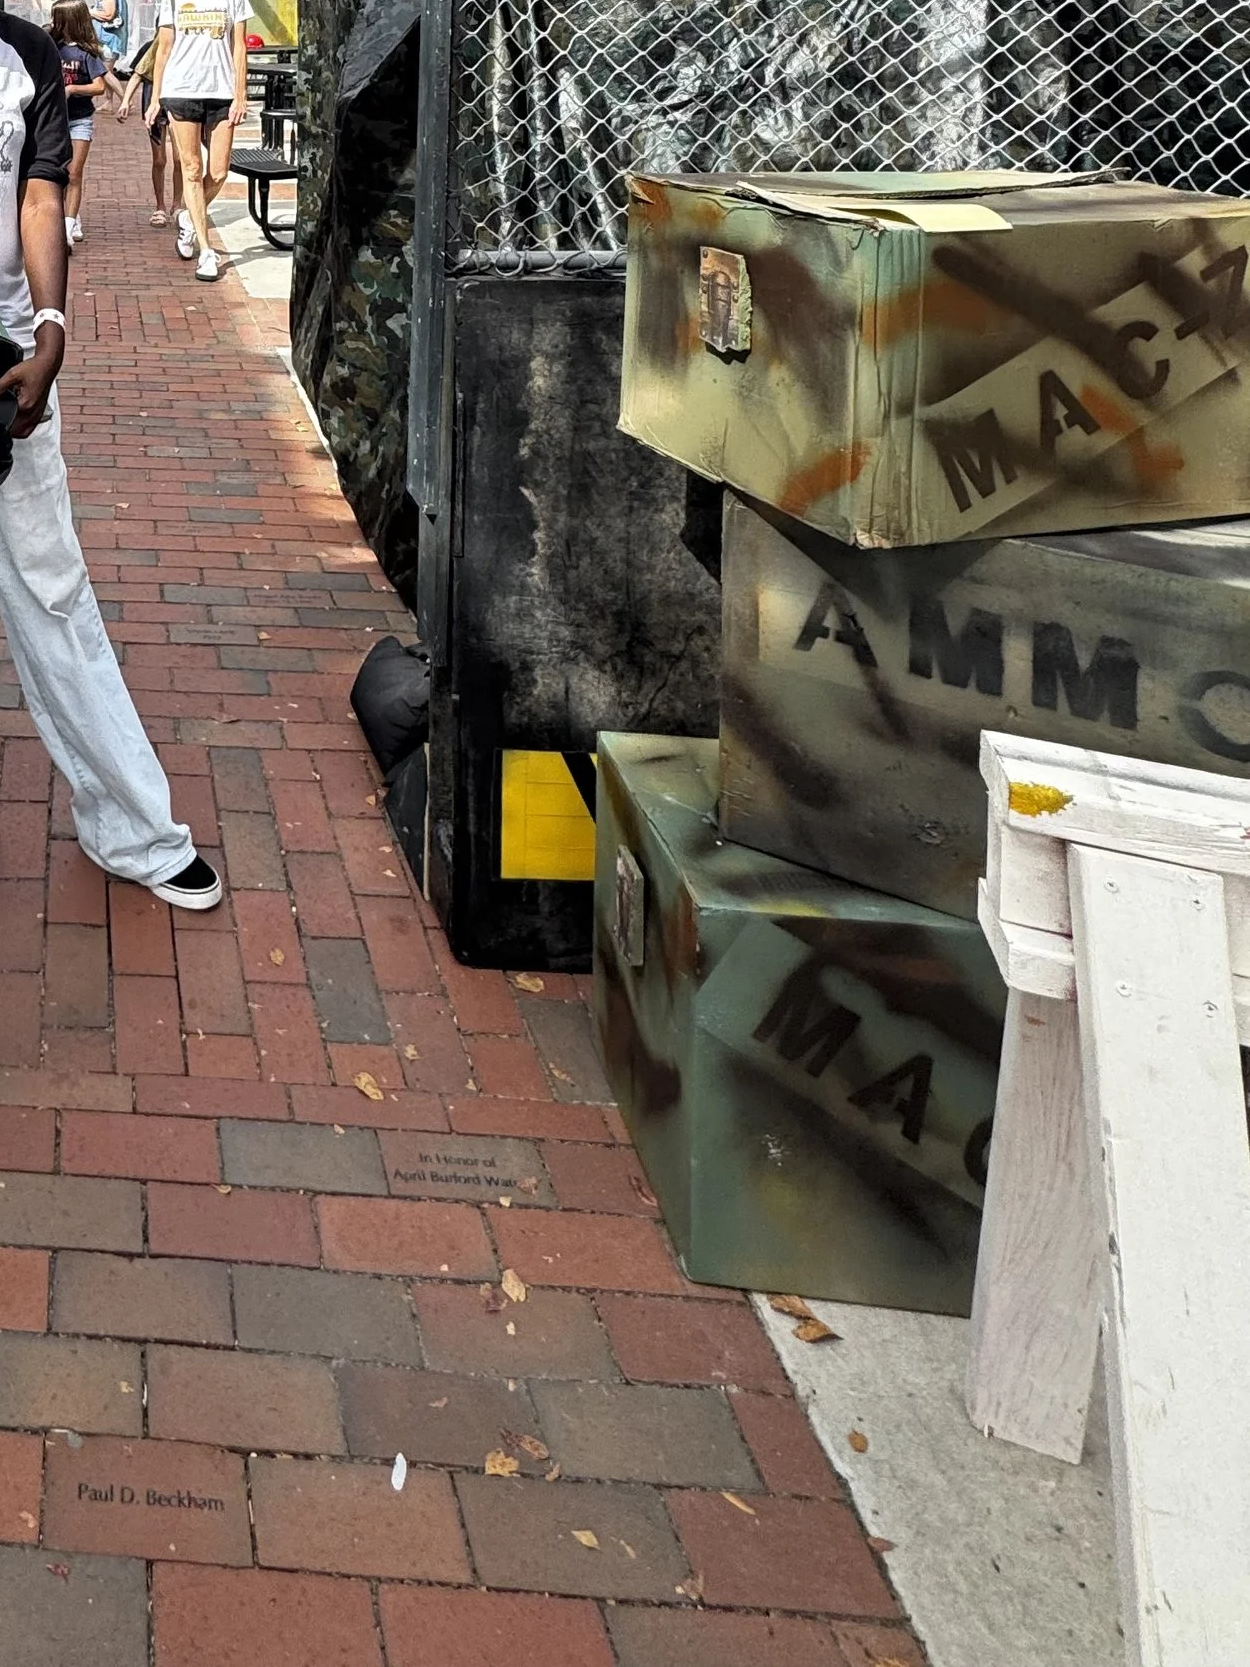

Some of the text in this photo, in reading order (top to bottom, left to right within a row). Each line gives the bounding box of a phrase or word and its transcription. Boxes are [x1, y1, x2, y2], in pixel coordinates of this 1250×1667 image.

[436, 1153, 479, 1166] Honor
[393, 1168, 426, 1183] April
[77, 1482, 225, 1511] Paul D. Beckham
